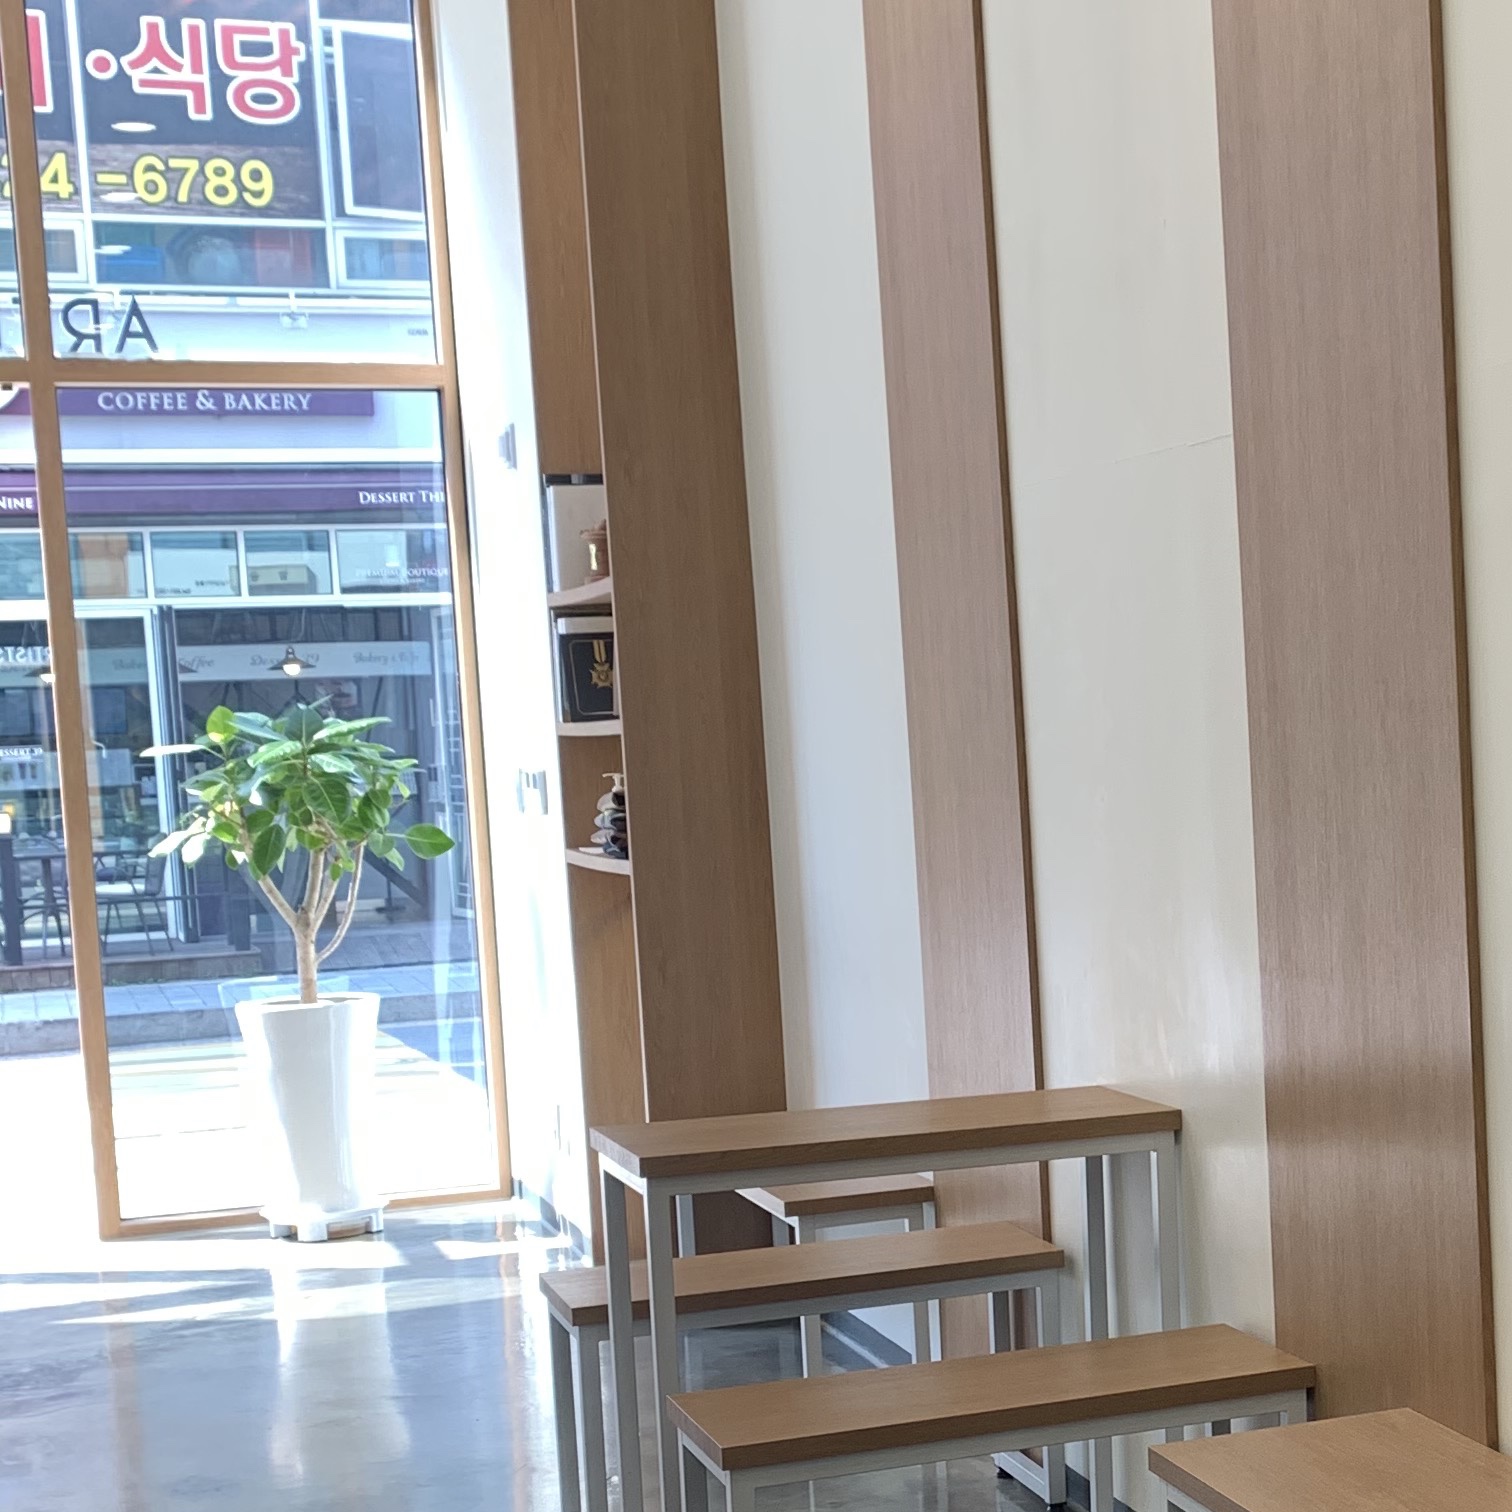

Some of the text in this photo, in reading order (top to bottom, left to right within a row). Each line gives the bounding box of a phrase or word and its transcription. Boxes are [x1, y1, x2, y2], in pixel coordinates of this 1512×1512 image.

[97, 389, 312, 411] COFFEE & BAKERY
